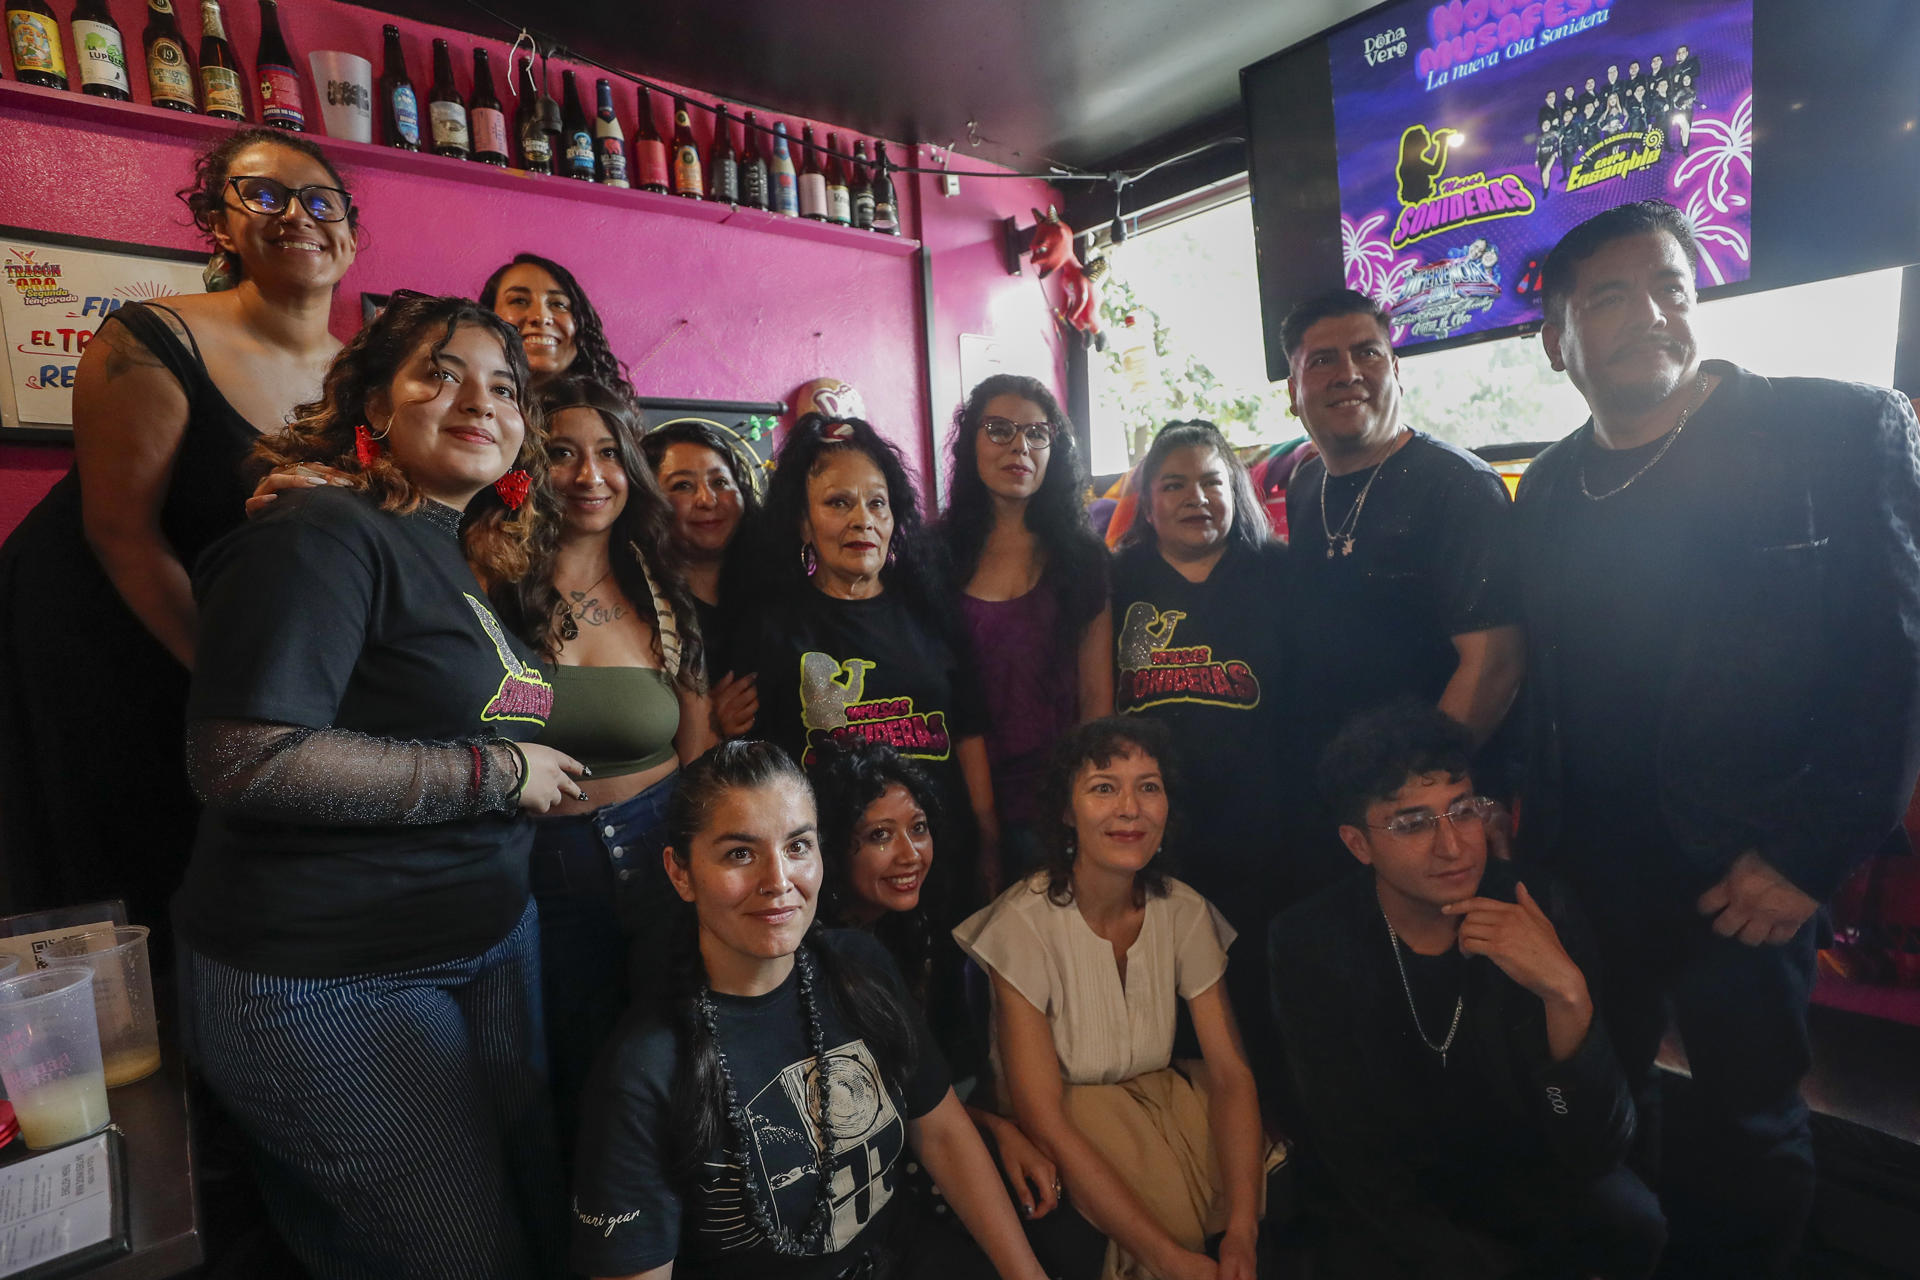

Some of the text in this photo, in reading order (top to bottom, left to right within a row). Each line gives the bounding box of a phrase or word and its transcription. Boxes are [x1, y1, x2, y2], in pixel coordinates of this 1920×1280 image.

[1420, 0, 1611, 75] MUSAFES
[1426, 8, 1609, 91] La nueva Ola Sonidera
[1365, 41, 1408, 67] Vero
[1566, 146, 1661, 192] Ensamble
[1394, 178, 1531, 242] SONIDERAS
[24, 295, 78, 305] Temporada
[26, 289, 68, 299] Segunda
[31, 331, 54, 346] EL
[574, 598, 629, 626] Love
[605, 1209, 641, 1238] gear
